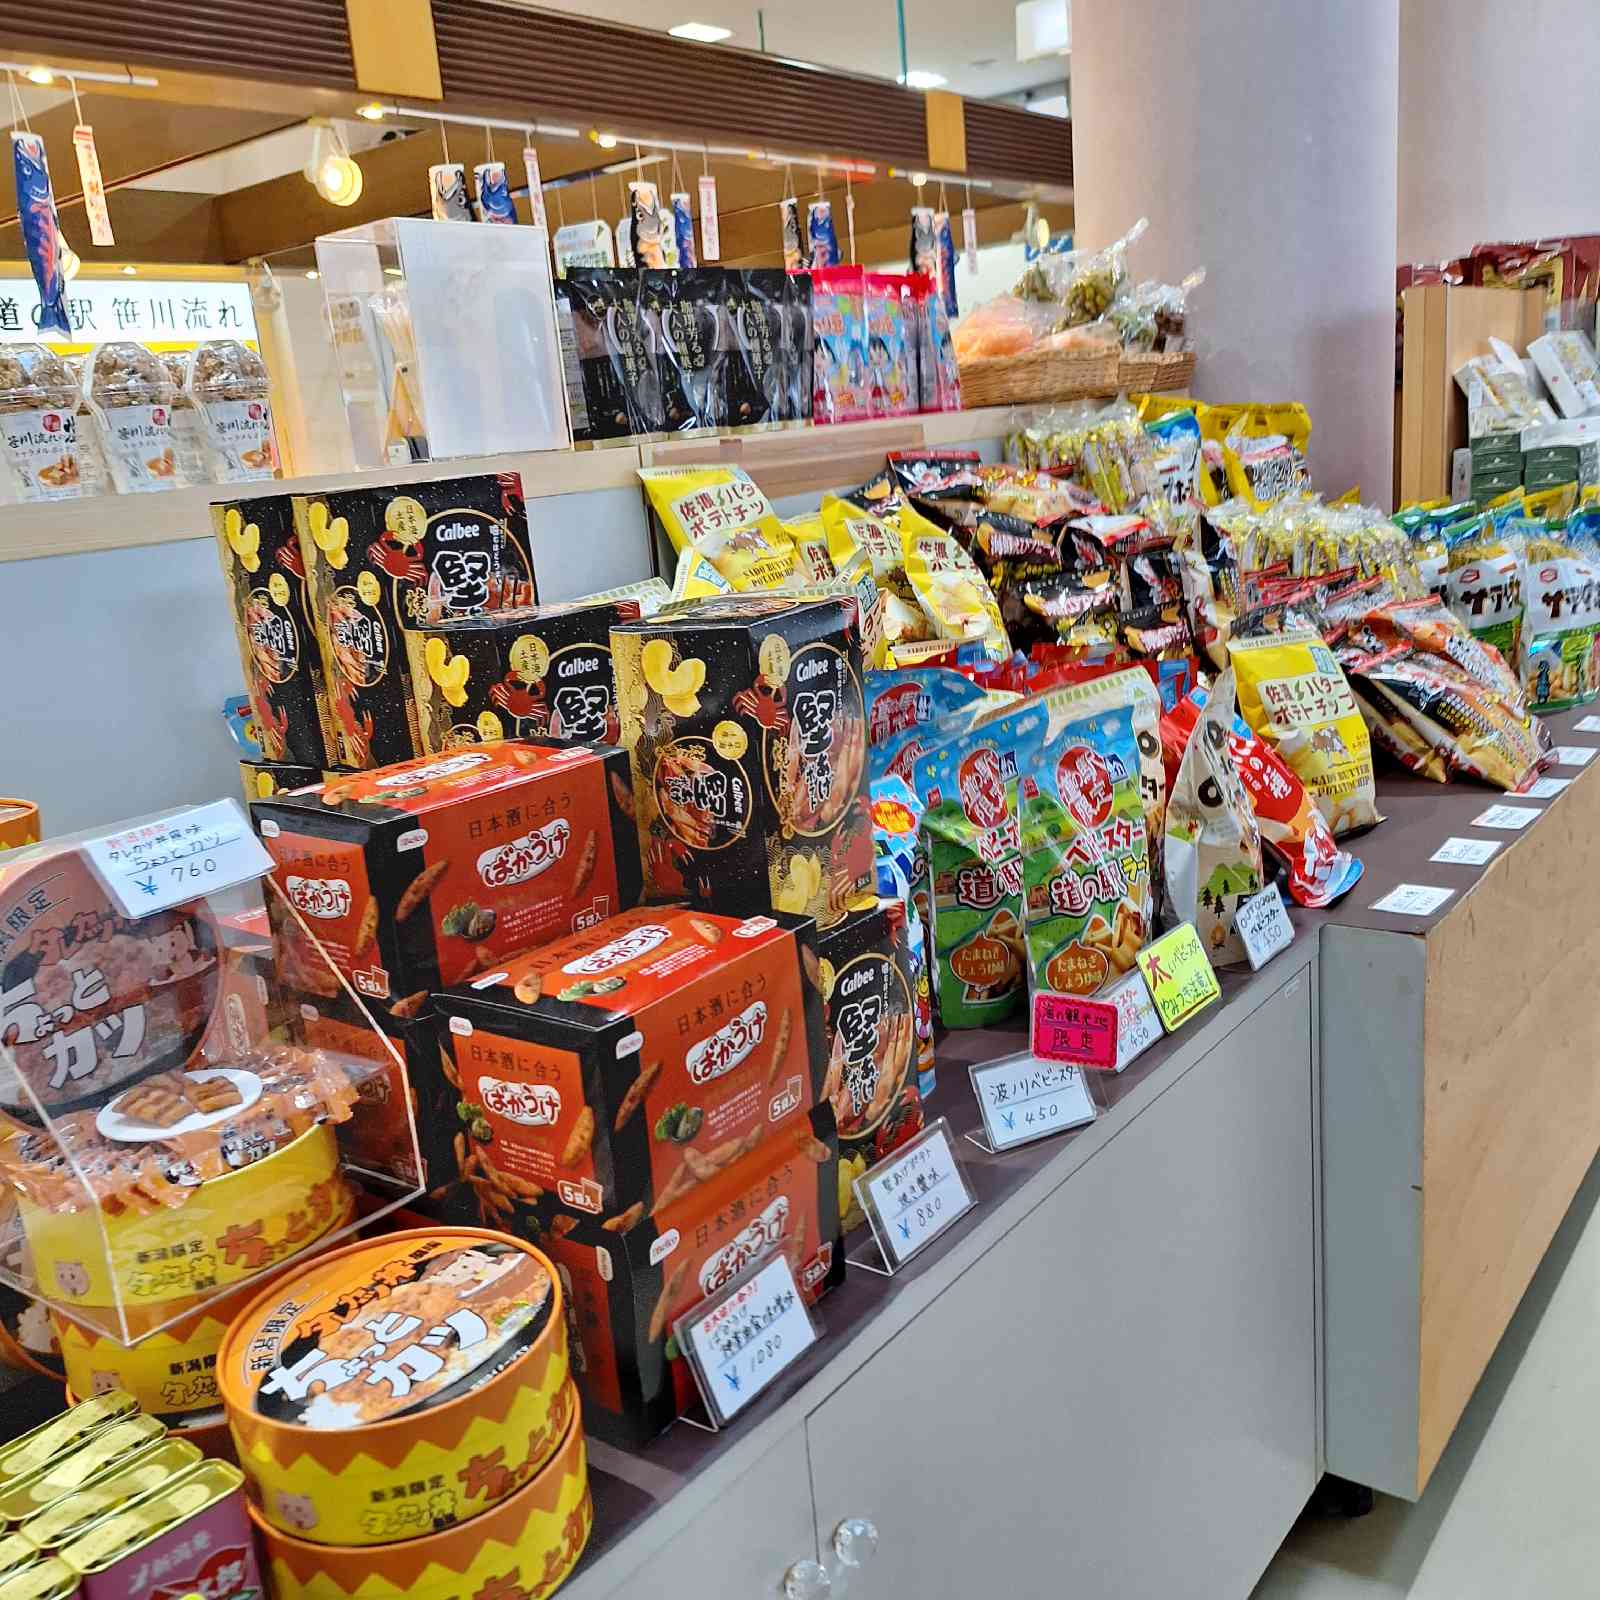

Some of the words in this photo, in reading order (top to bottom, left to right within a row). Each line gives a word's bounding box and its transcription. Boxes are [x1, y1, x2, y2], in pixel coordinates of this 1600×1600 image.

[112, 297, 243, 331] 笹川流れ
[435, 521, 480, 542] Calbee
[558, 656, 600, 678] Calbee
[796, 657, 829, 682] Calbee
[731, 776, 744, 814] Calbee
[467, 791, 572, 839] 日本酒に合う
[481, 824, 571, 888] ばかうけ
[133, 875, 159, 896] ¥
[170, 858, 217, 882] 760
[1052, 866, 1126, 916] 道の駅
[289, 881, 353, 917] ばかうけ
[840, 967, 875, 997] Calbee
[1056, 953, 1098, 973] たまねぎ
[676, 974, 767, 1036] 日本酒に合う
[43, 1004, 145, 1088] カツ
[471, 1044, 562, 1082] 日本酒に合う
[692, 1009, 768, 1083] ばかうけ
[483, 1084, 560, 1122] ばかうけ
[1001, 1111, 1016, 1131] ¥
[1024, 1103, 1059, 1128] 450
[897, 1217, 912, 1240] ¥
[915, 1196, 943, 1228] 880
[258, 1310, 424, 1400] ちょっと
[365, 1307, 489, 1398] カツ
[723, 1366, 741, 1391] ¥
[750, 1333, 783, 1374] 1080
